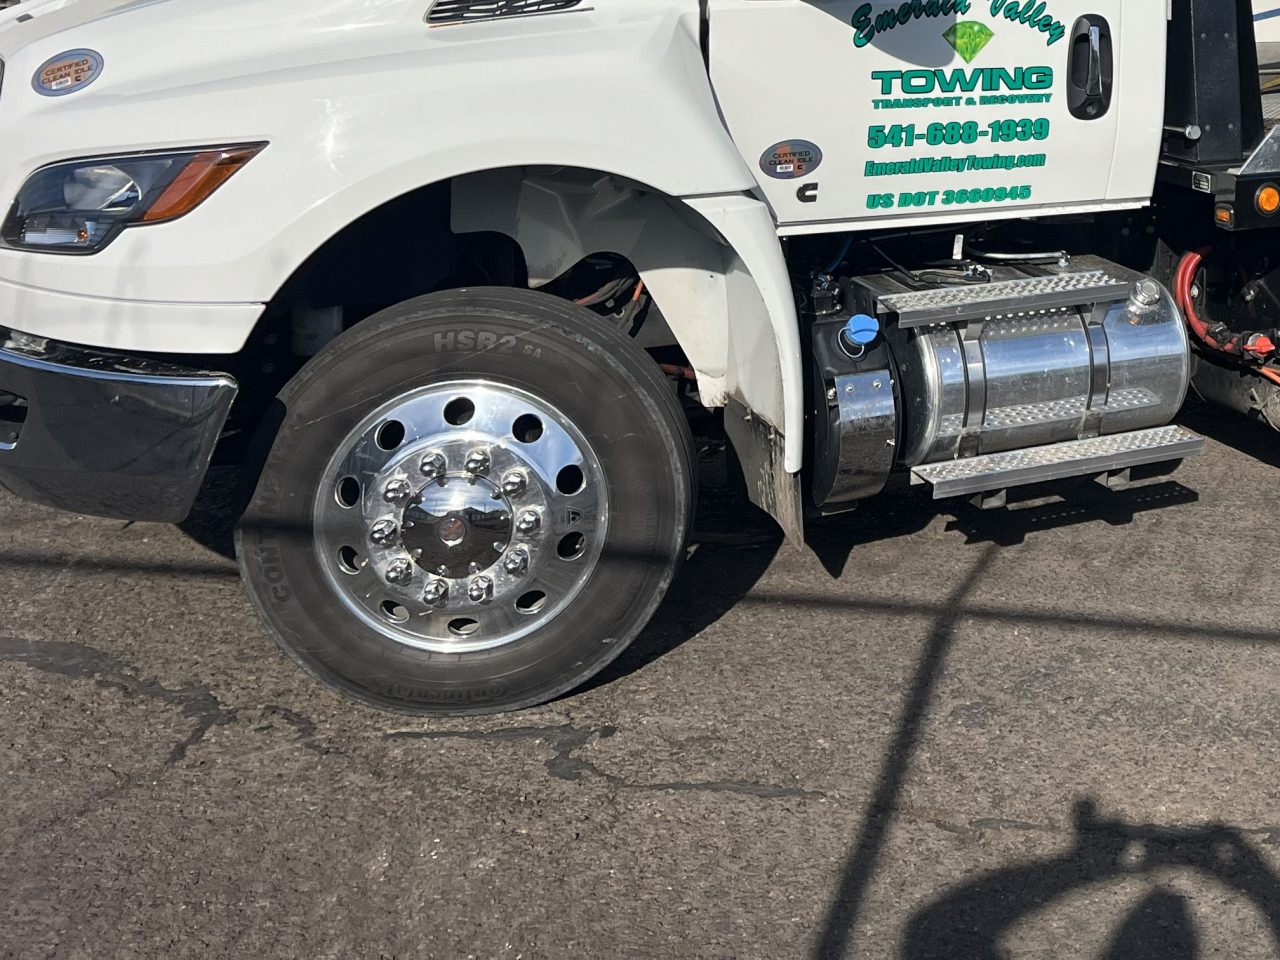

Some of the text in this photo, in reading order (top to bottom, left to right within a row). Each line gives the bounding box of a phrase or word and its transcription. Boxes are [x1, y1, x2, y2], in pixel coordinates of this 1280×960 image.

[41, 71, 71, 84] CLEAN
[74, 65, 94, 75] IDLE
[45, 59, 89, 76] CERTIFIED
[871, 66, 1053, 95] TOWING
[872, 93, 1053, 109] TRANSPORT & RECOVERY
[867, 117, 1050, 148] 541-688-1939
[768, 158, 794, 166] CLEAN
[773, 150, 811, 159] CERTIFIED
[864, 152, 1047, 176] EmeraldValleyTowing.com
[866, 193, 895, 209] US
[898, 191, 940, 207] DOT
[433, 329, 517, 355] HSR2
